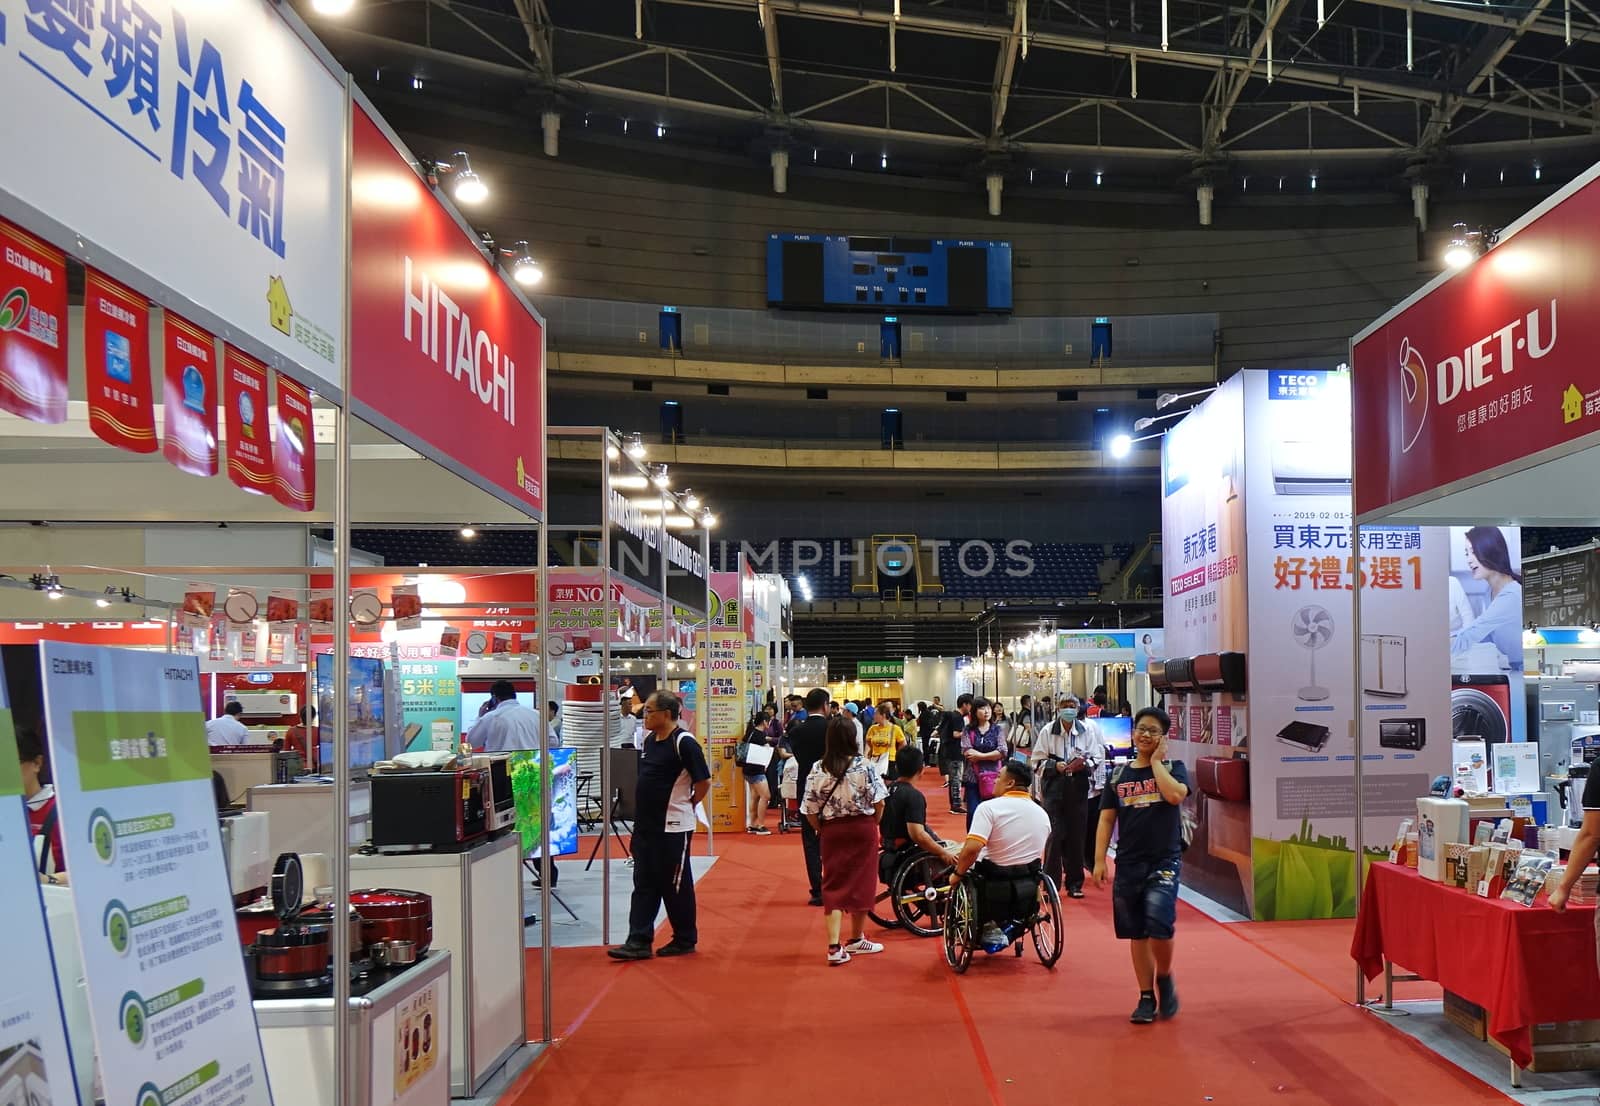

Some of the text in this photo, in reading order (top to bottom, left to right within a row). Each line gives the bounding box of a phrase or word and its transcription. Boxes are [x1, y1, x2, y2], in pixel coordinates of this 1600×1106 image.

[404, 255, 516, 427] HITACHI
[1279, 375, 1317, 385] TECO
[1457, 384, 1533, 433] 您健康的好朋友
[1183, 523, 1217, 564] 東元家電
[1273, 556, 1423, 590] 好禮5選1
[164, 667, 194, 681] HITACHI
[1117, 779, 1160, 798] STAN
